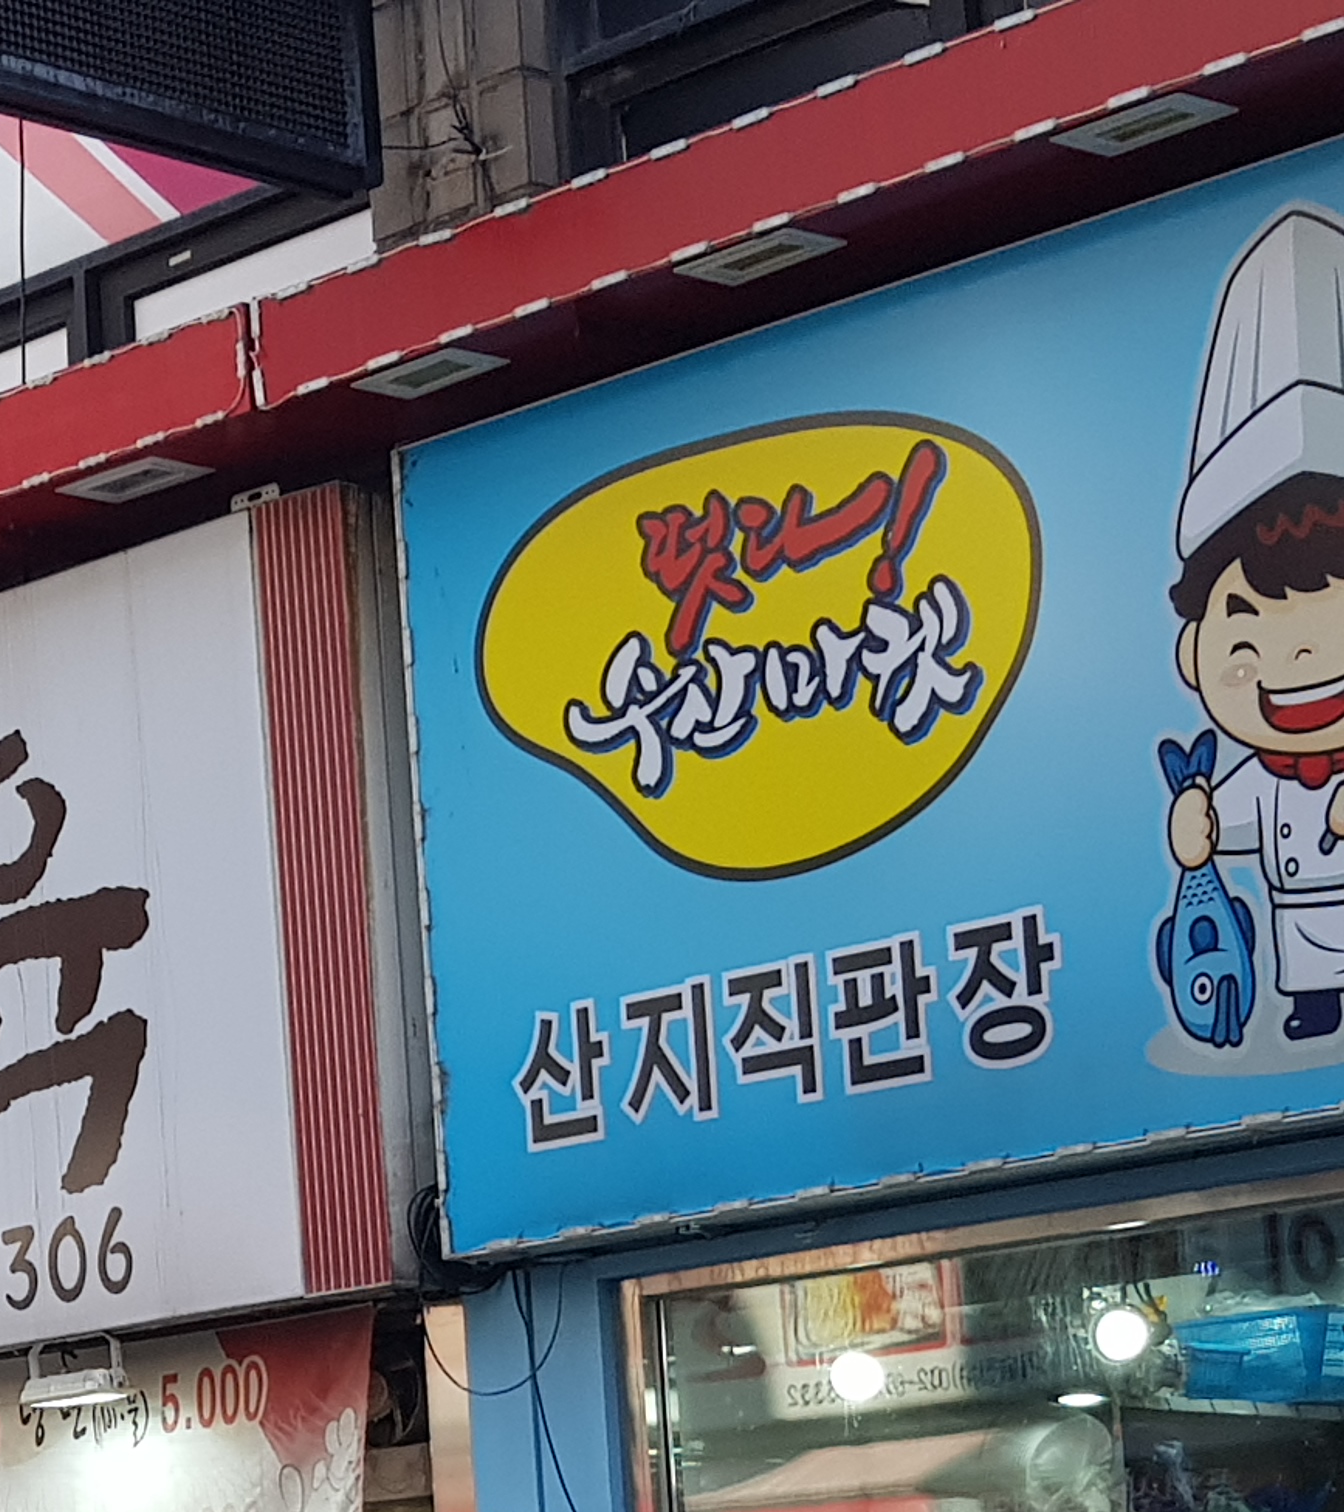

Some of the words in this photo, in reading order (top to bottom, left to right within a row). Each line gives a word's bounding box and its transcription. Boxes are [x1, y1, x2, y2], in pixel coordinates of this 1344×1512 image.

[564, 574, 986, 798] 수산마켓
[515, 905, 1063, 1152] 산지직판장
[162, 1360, 264, 1434] 5.000
